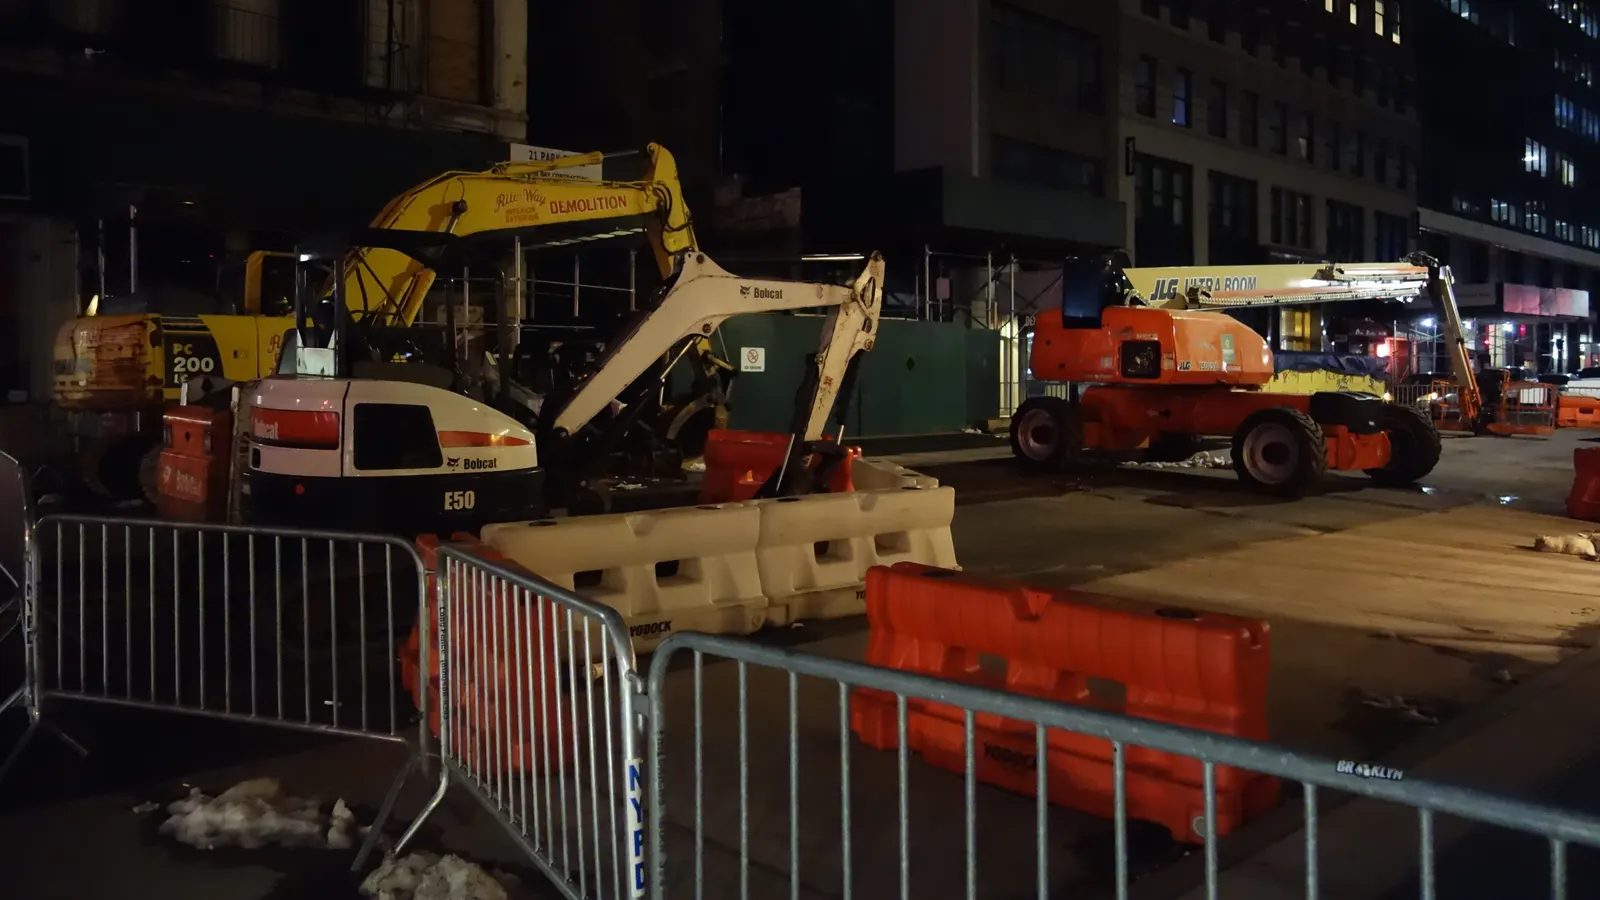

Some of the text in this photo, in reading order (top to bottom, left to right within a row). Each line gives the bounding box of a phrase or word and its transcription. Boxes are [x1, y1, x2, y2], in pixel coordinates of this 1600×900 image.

[528, 150, 538, 161] 21
[550, 196, 627, 215] DEMOLITION
[505, 213, 539, 223] EXTERIOR
[754, 287, 783, 300] Bobcat
[1150, 278, 1179, 301] JLG
[1225, 276, 1257, 292] BOOM
[172, 342, 193, 356] PC
[173, 356, 215, 373] 200
[464, 457, 497, 470] Bobcat
[444, 490, 475, 511] E50
[630, 620, 672, 637] YODOCK
